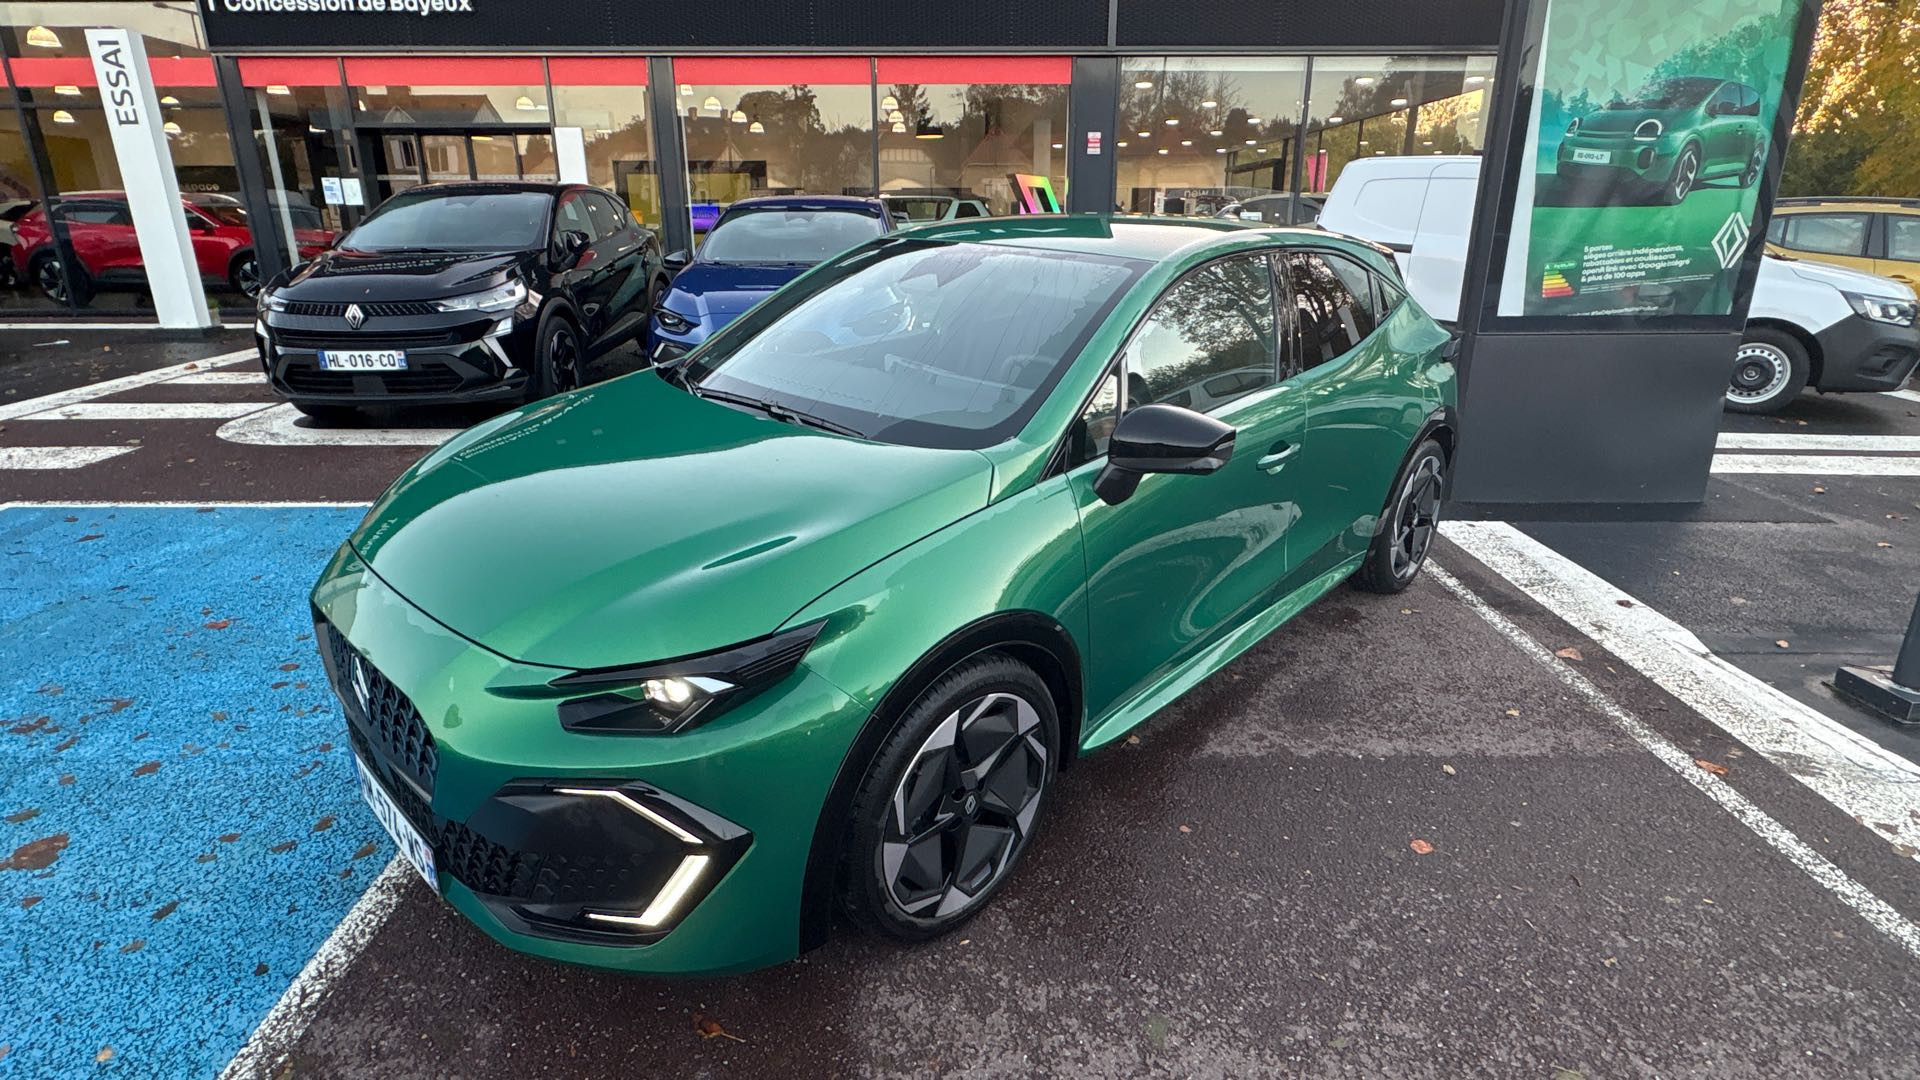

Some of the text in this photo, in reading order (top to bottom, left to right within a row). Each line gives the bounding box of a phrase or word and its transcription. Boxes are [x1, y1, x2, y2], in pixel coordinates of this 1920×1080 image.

[224, 0, 473, 16] Concession de Bayeux
[97, 40, 140, 126] ESSAI
